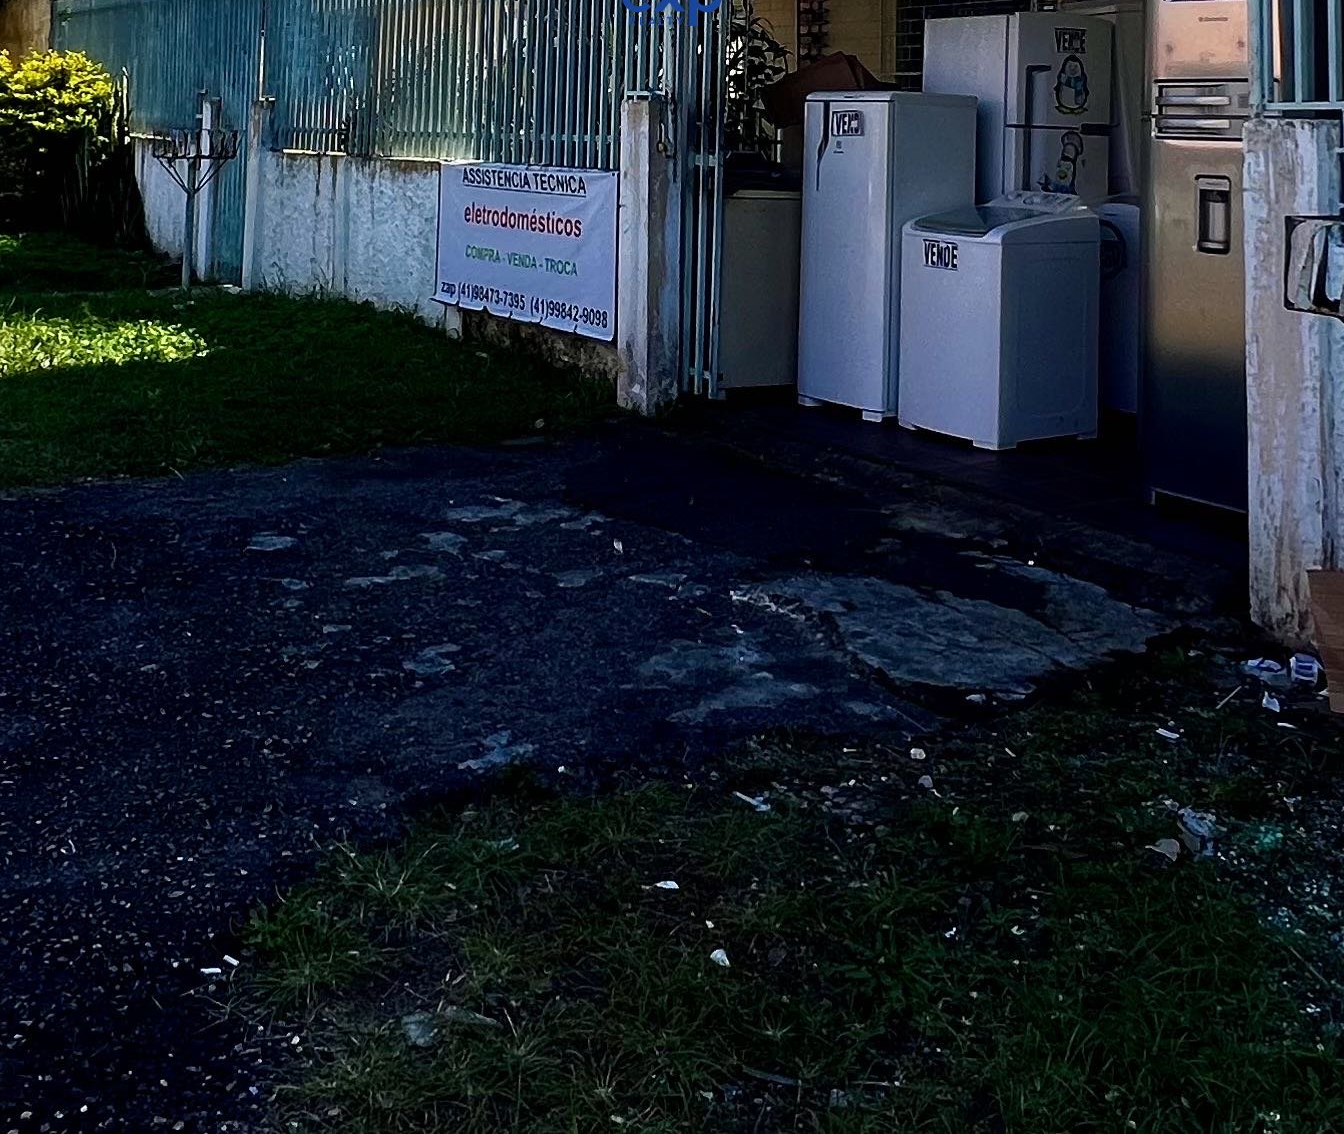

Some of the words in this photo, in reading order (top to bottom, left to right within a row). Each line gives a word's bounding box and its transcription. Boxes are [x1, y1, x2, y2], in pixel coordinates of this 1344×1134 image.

[462, 168, 531, 189] ASSISTENCIA
[533, 173, 586, 194] TECNICA
[464, 202, 582, 237] eletrodomésticos
[465, 245, 501, 262] COMPRA
[507, 252, 537, 269] VENDA
[544, 258, 577, 276] TROCA
[924, 242, 958, 268] VENDE
[441, 282, 456, 297] zap
[458, 282, 526, 310] (41)98473-7395
